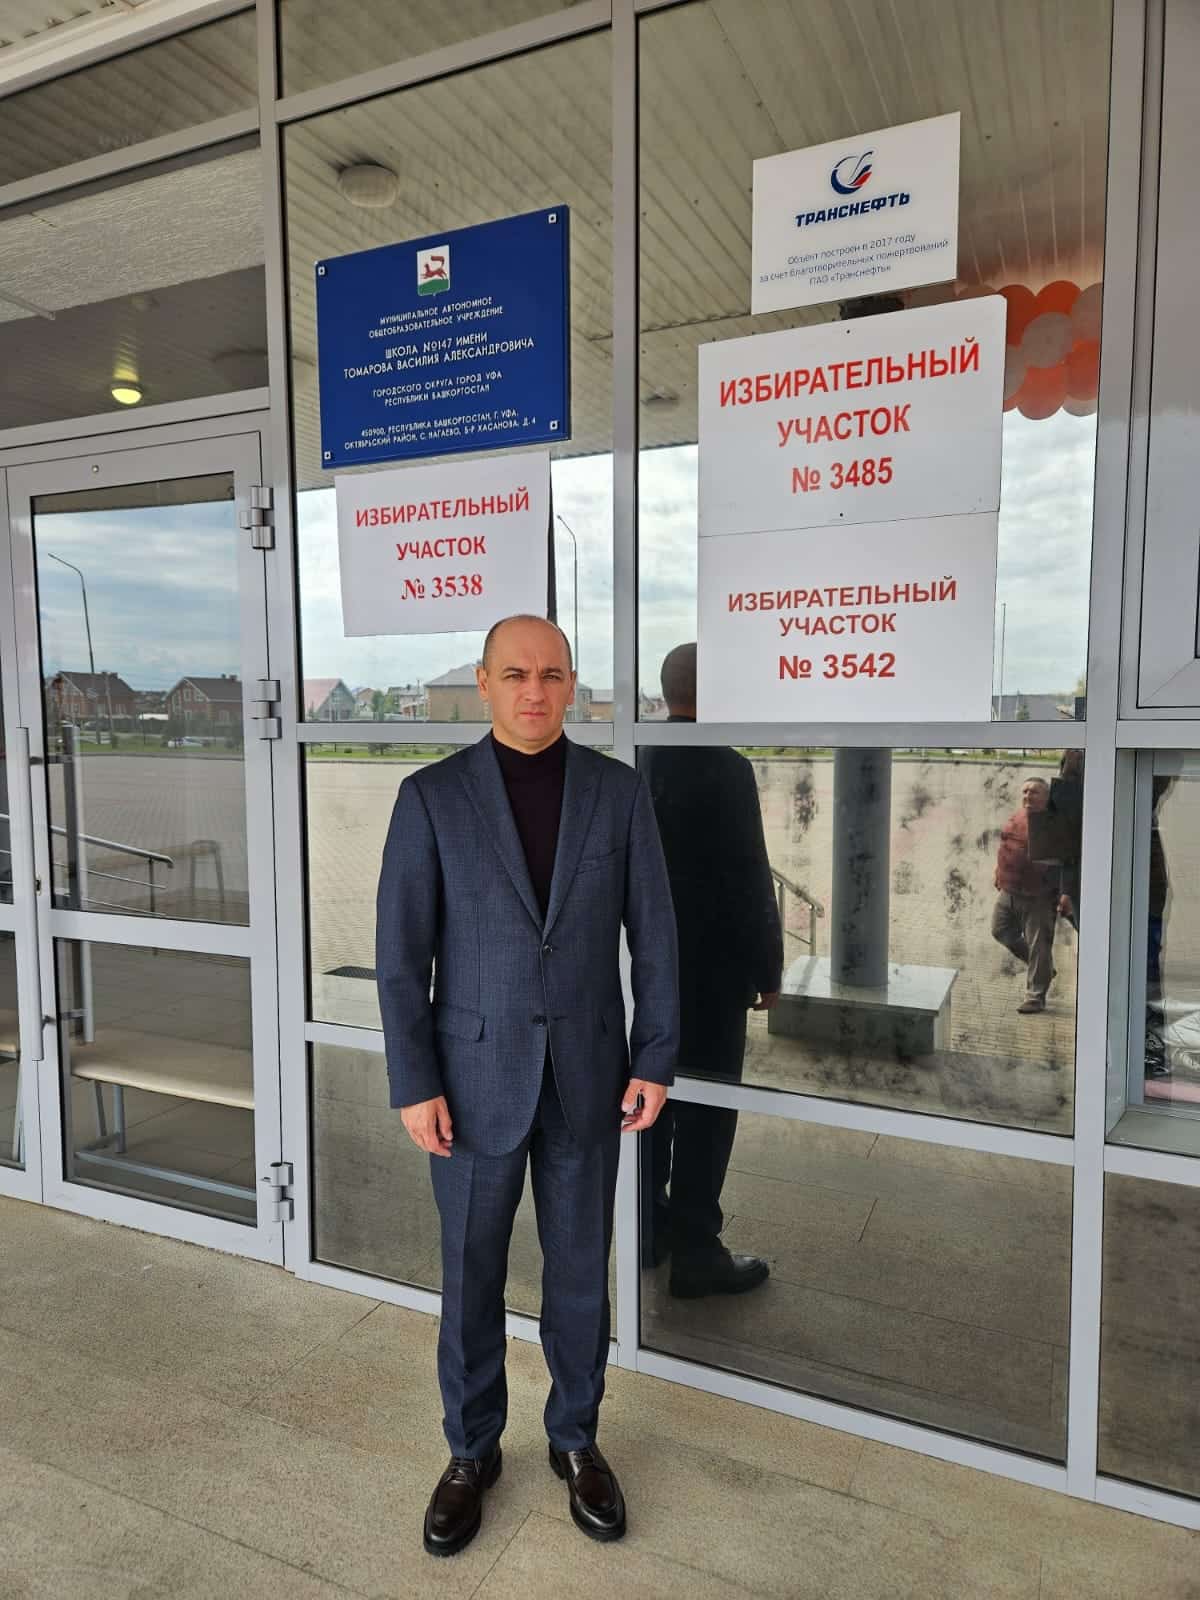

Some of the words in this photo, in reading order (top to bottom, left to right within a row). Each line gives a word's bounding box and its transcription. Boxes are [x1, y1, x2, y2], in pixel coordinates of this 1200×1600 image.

[795, 192, 911, 227] ТРАНСНЕФТЬ
[870, 236, 893, 249] 2017
[894, 233, 916, 246] году
[759, 274, 769, 283] за
[809, 274, 829, 287] ПАО
[368, 316, 453, 338] ОБЩЕОБРАЗОВАТЕЛЬНОЕ
[456, 305, 503, 322] УЧРЕЖДЕНИЕ
[380, 307, 438, 325] МУНИЦИПАЛЬНОЕ
[442, 296, 492, 314] АВТОНОМНОЕ
[343, 363, 393, 379] ТОМАРОВА
[397, 353, 439, 370] ВАСИЛИЯ
[443, 337, 535, 361] АЛЕКСАНДРОВИЧА
[385, 344, 418, 359] ШКОЛА
[456, 332, 488, 346] ИМЕНИ
[373, 383, 422, 398] ГОРОДСКОГО
[425, 379, 453, 389] ОКРУГА
[456, 374, 482, 385] ГОРОД
[485, 371, 502, 380] УФА
[720, 336, 980, 407] ИЗБИРАТЕЛЬНЫЙ
[384, 393, 429, 407] РЕСПУБЛИКИ
[432, 383, 490, 400] БАШКОРТОСТАН
[388, 420, 432, 434] РЕСПУБЛИКА
[777, 404, 911, 447] УЧАСТОК
[344, 436, 391, 450] ОКТЯБРЬСКИЙ
[792, 466, 820, 494] №
[830, 457, 892, 489] 3485
[355, 486, 530, 528] ИЗБИРАТЕЛЬНЫЙ
[396, 535, 486, 560] УЧАСТОК
[401, 577, 425, 600] №
[431, 574, 483, 598] 3538
[728, 575, 957, 612] ИЗБИРАТЕЛЬНЫЙ
[779, 613, 896, 636] УЧАСТОК
[779, 655, 812, 679] №
[823, 652, 896, 679] 3542
